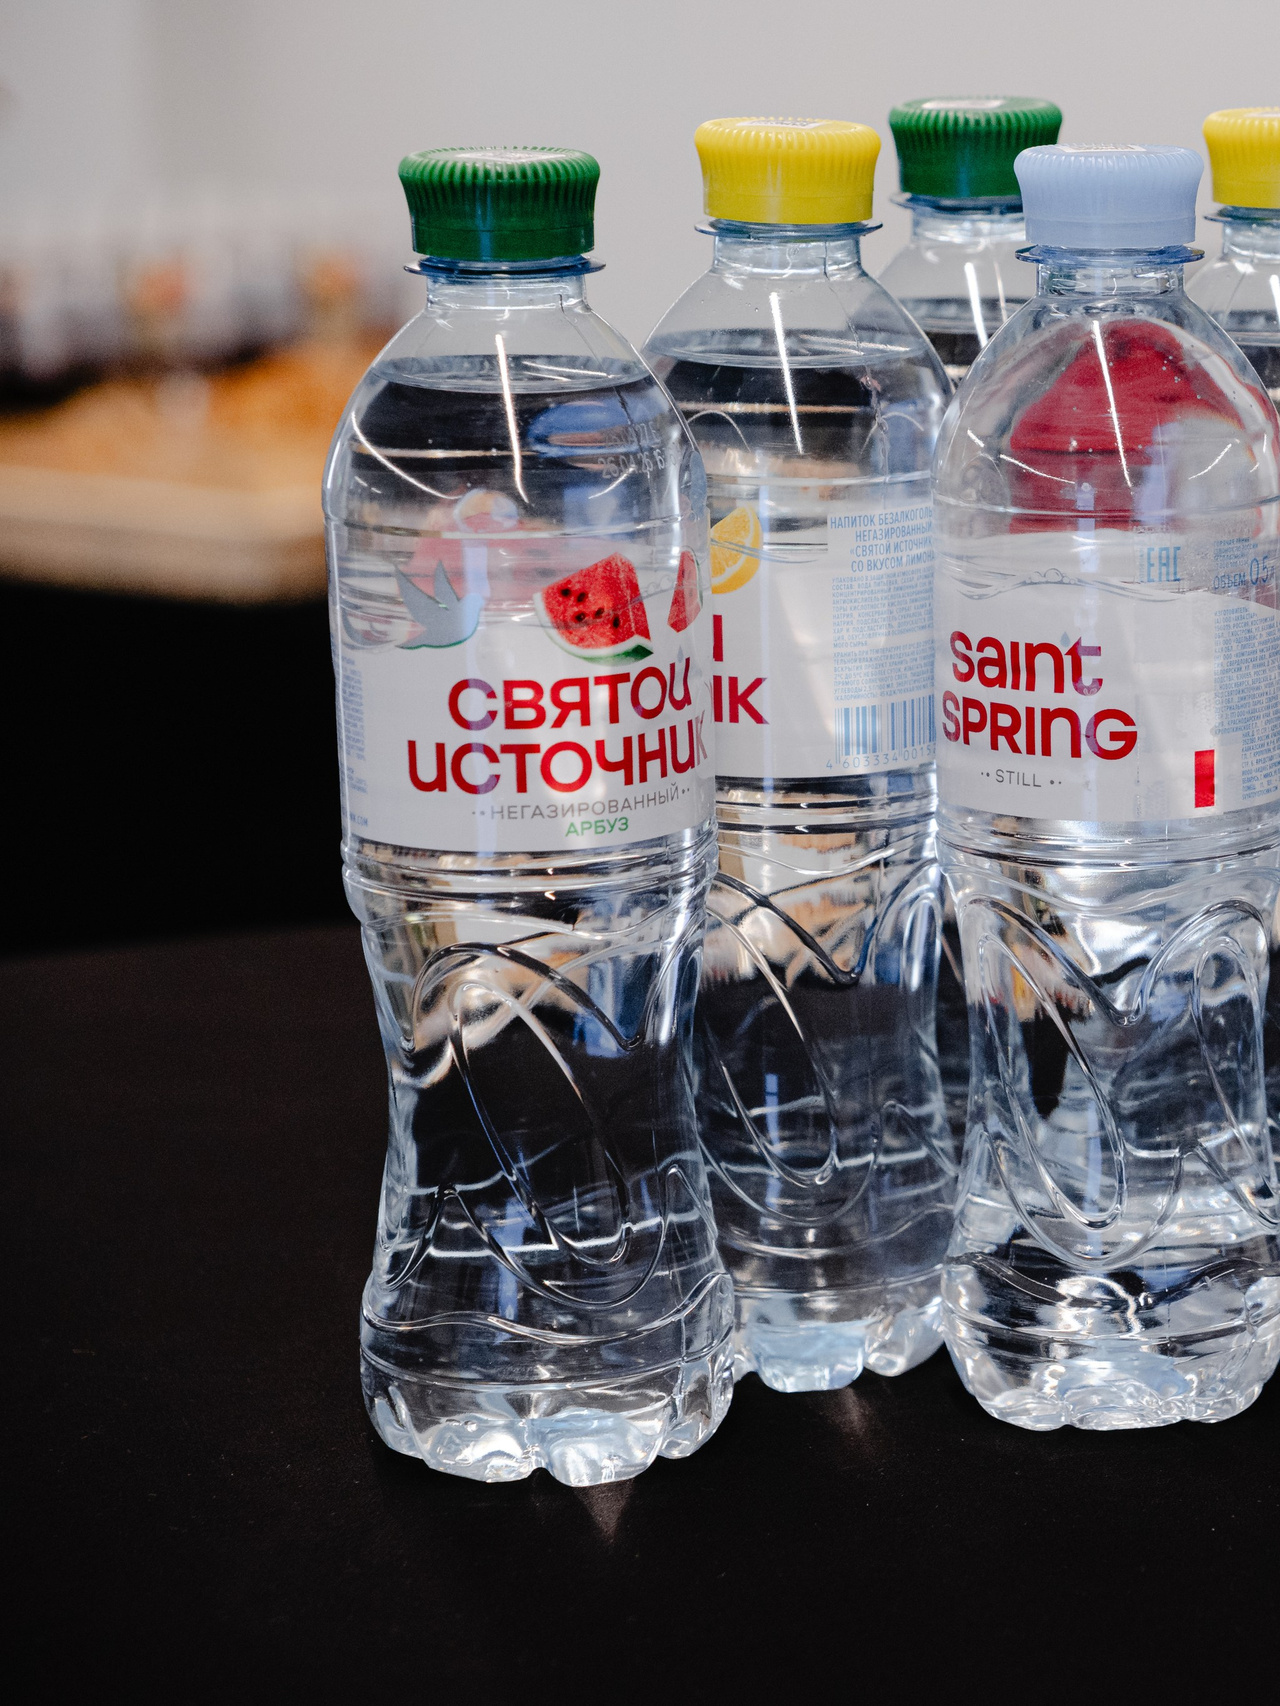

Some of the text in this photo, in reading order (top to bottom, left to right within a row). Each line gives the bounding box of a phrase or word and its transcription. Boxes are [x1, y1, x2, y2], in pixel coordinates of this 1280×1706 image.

[830, 514, 876, 529] НАПИТОК
[850, 541, 891, 558] «СВЯТОЙ
[851, 560, 864, 573] СО
[866, 556, 903, 572] ВКУСОМ
[995, 769, 1042, 788] STILL
[490, 784, 679, 820] НЕГАЗИРОВАННЫЙ
[565, 816, 630, 838] АРБУЗ
